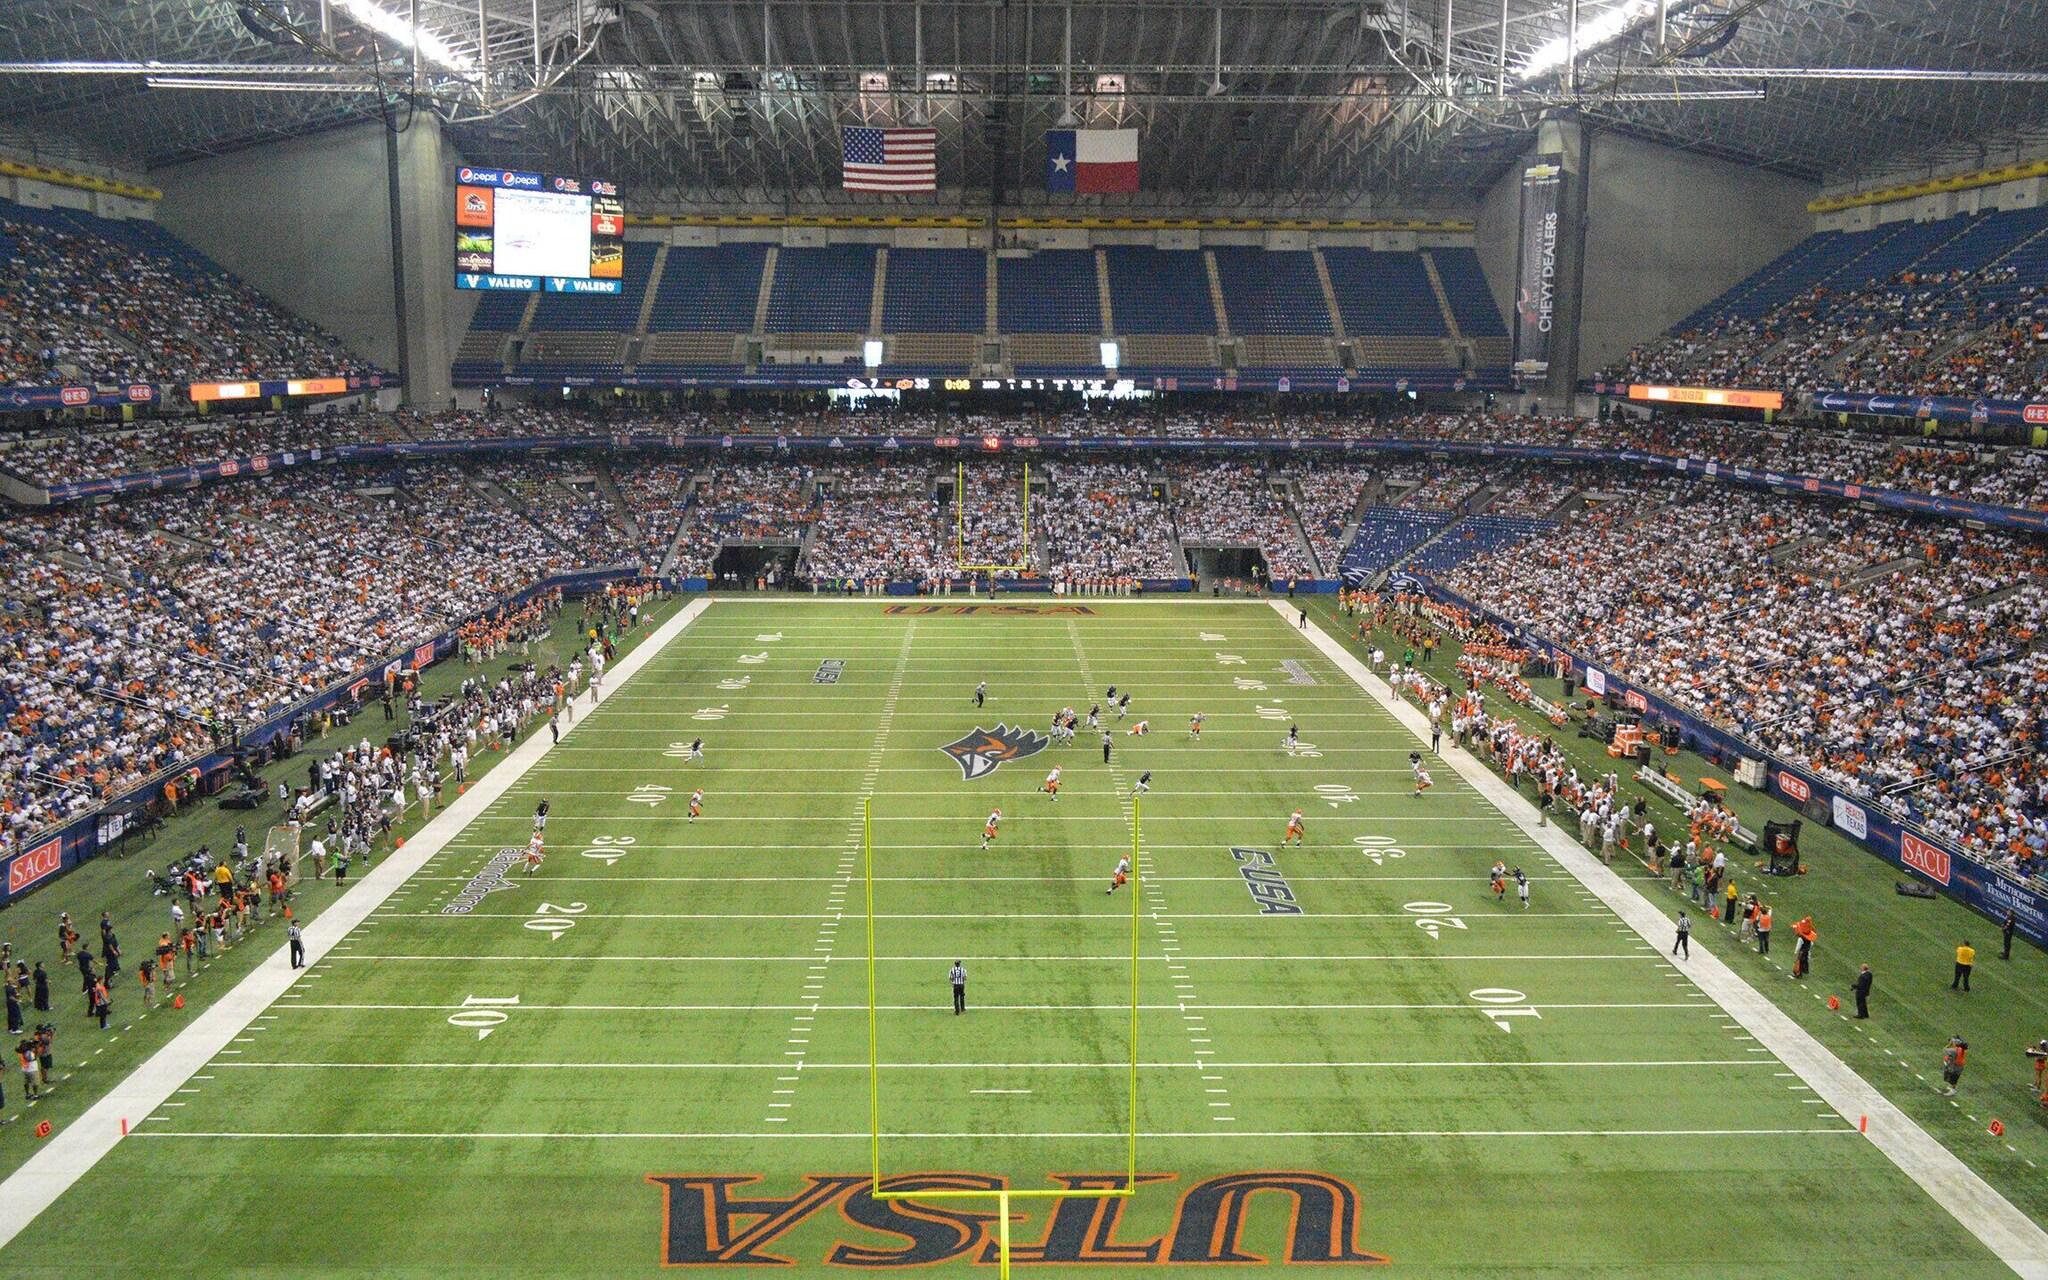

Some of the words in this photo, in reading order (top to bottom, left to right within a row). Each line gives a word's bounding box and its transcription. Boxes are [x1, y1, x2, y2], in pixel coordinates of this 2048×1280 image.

[473, 173, 497, 183] pepsi
[515, 176, 538, 186] pepsi
[1542, 212, 1557, 277] DEALERS
[488, 277, 532, 288] VALERO
[574, 281, 615, 291] VALERO
[1539, 281, 1553, 332] CHEVY
[985, 439, 998, 448] 40
[883, 606, 1096, 615] UTSA
[626, 783, 672, 802] 40
[1313, 784, 1360, 803] 40
[1781, 777, 1807, 798] H-E-B
[581, 836, 636, 858] 30
[1353, 836, 1406, 858] 30
[13, 844, 59, 886] SACU
[1904, 838, 1948, 879] SACU
[524, 902, 588, 930] 20
[1403, 902, 1468, 931] 20
[447, 994, 520, 1027] 10
[1469, 988, 1542, 1020] 10
[645, 1171, 1392, 1268] UTSA
